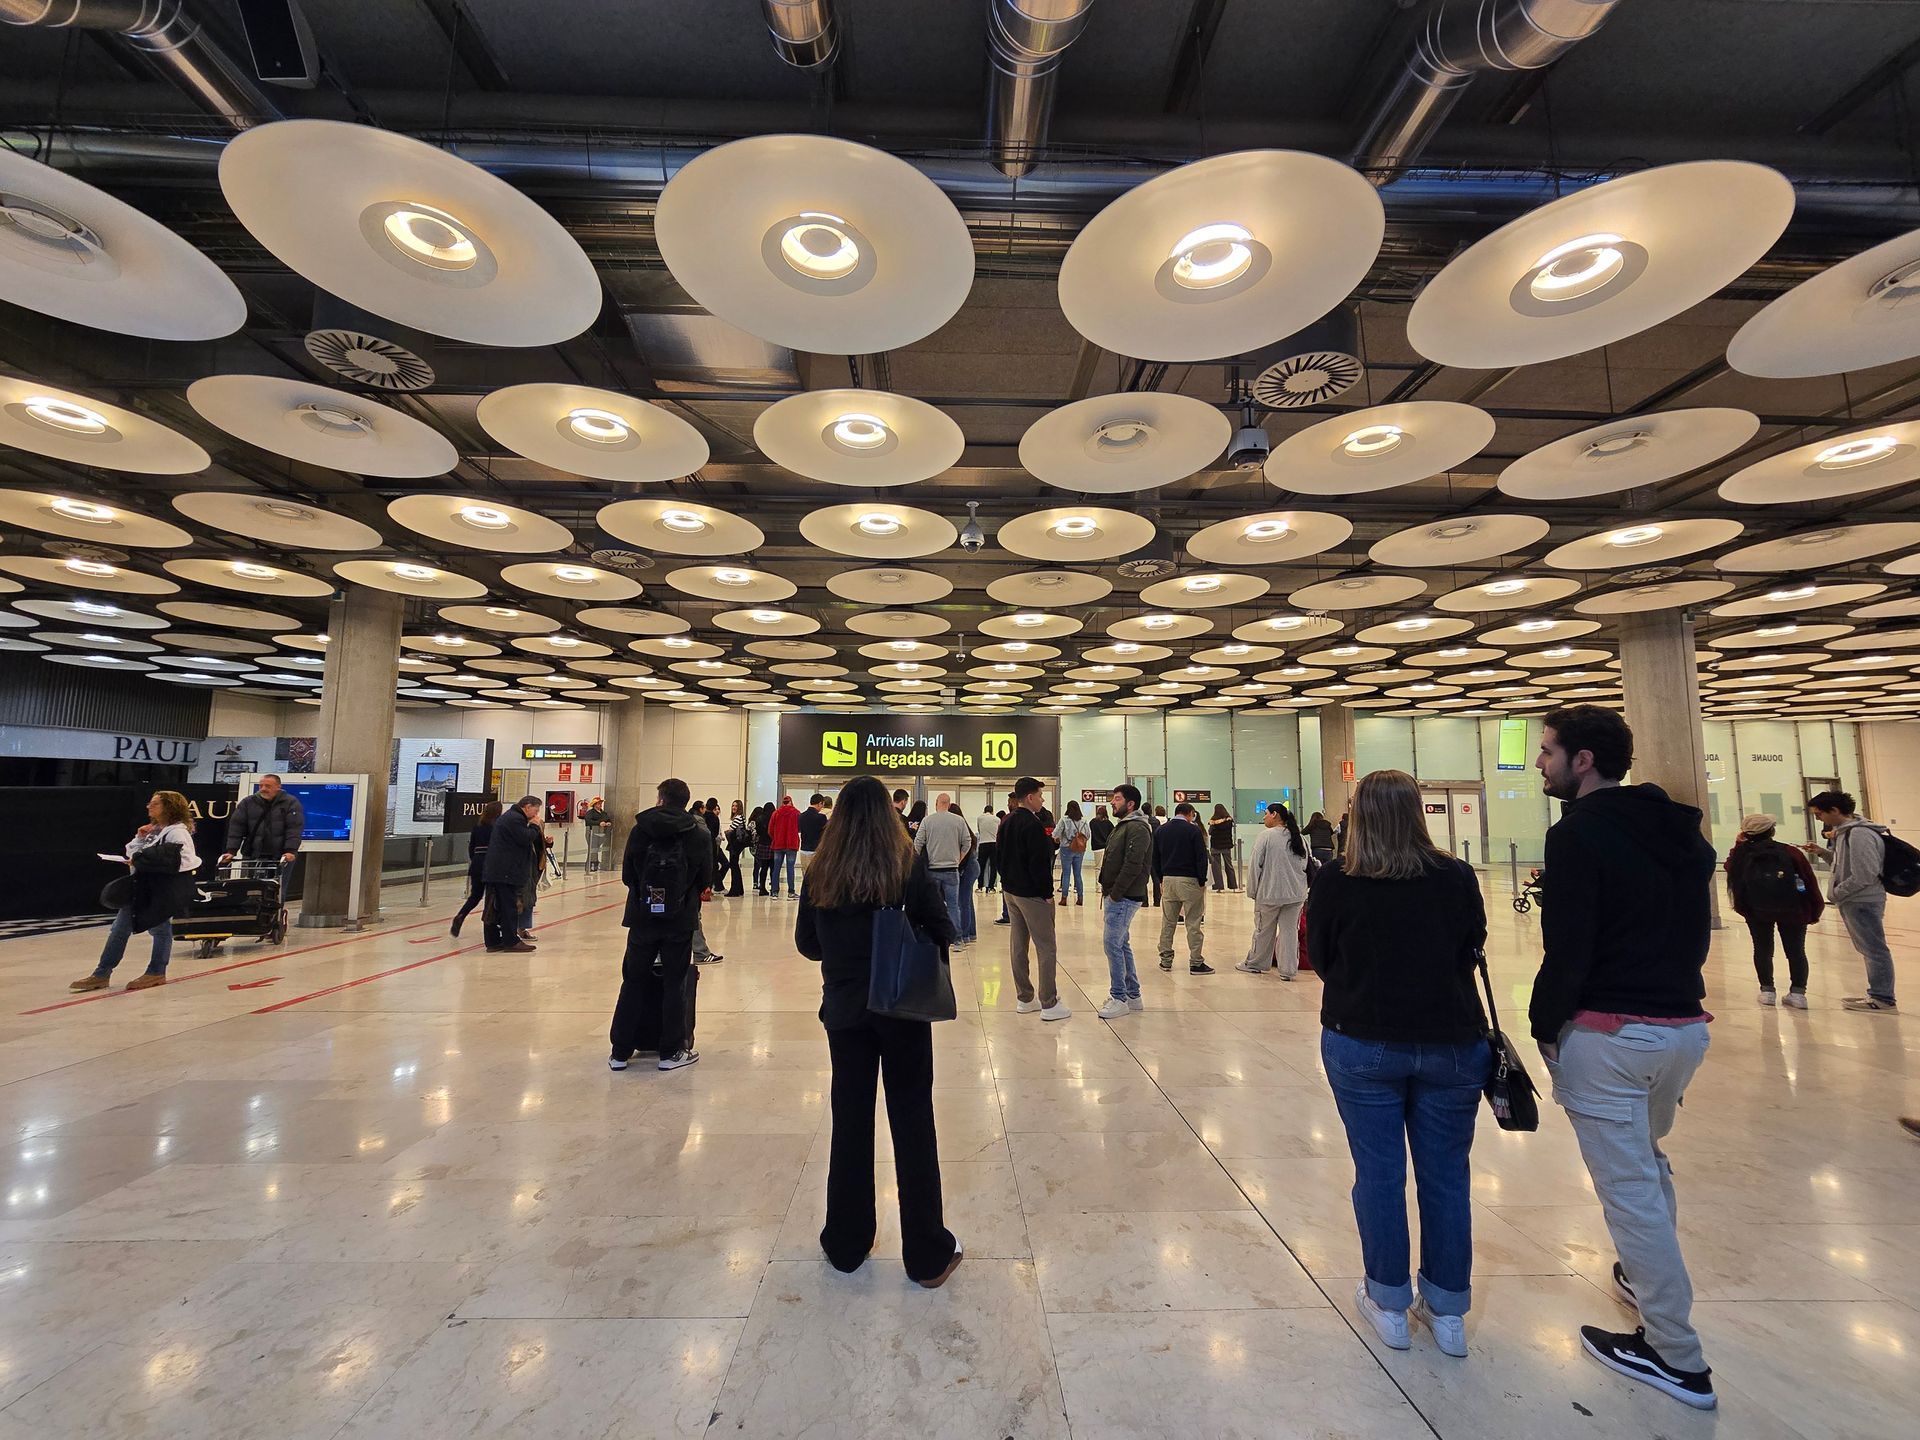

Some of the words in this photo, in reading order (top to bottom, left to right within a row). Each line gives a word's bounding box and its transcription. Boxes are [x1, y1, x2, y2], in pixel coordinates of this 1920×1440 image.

[113, 736, 197, 763] PAUL
[866, 734, 915, 747] Arrivals
[919, 734, 944, 748] hall
[985, 739, 1014, 762] 10
[866, 750, 935, 769] Llegadas
[939, 750, 973, 767] Sala
[187, 800, 238, 819] AU
